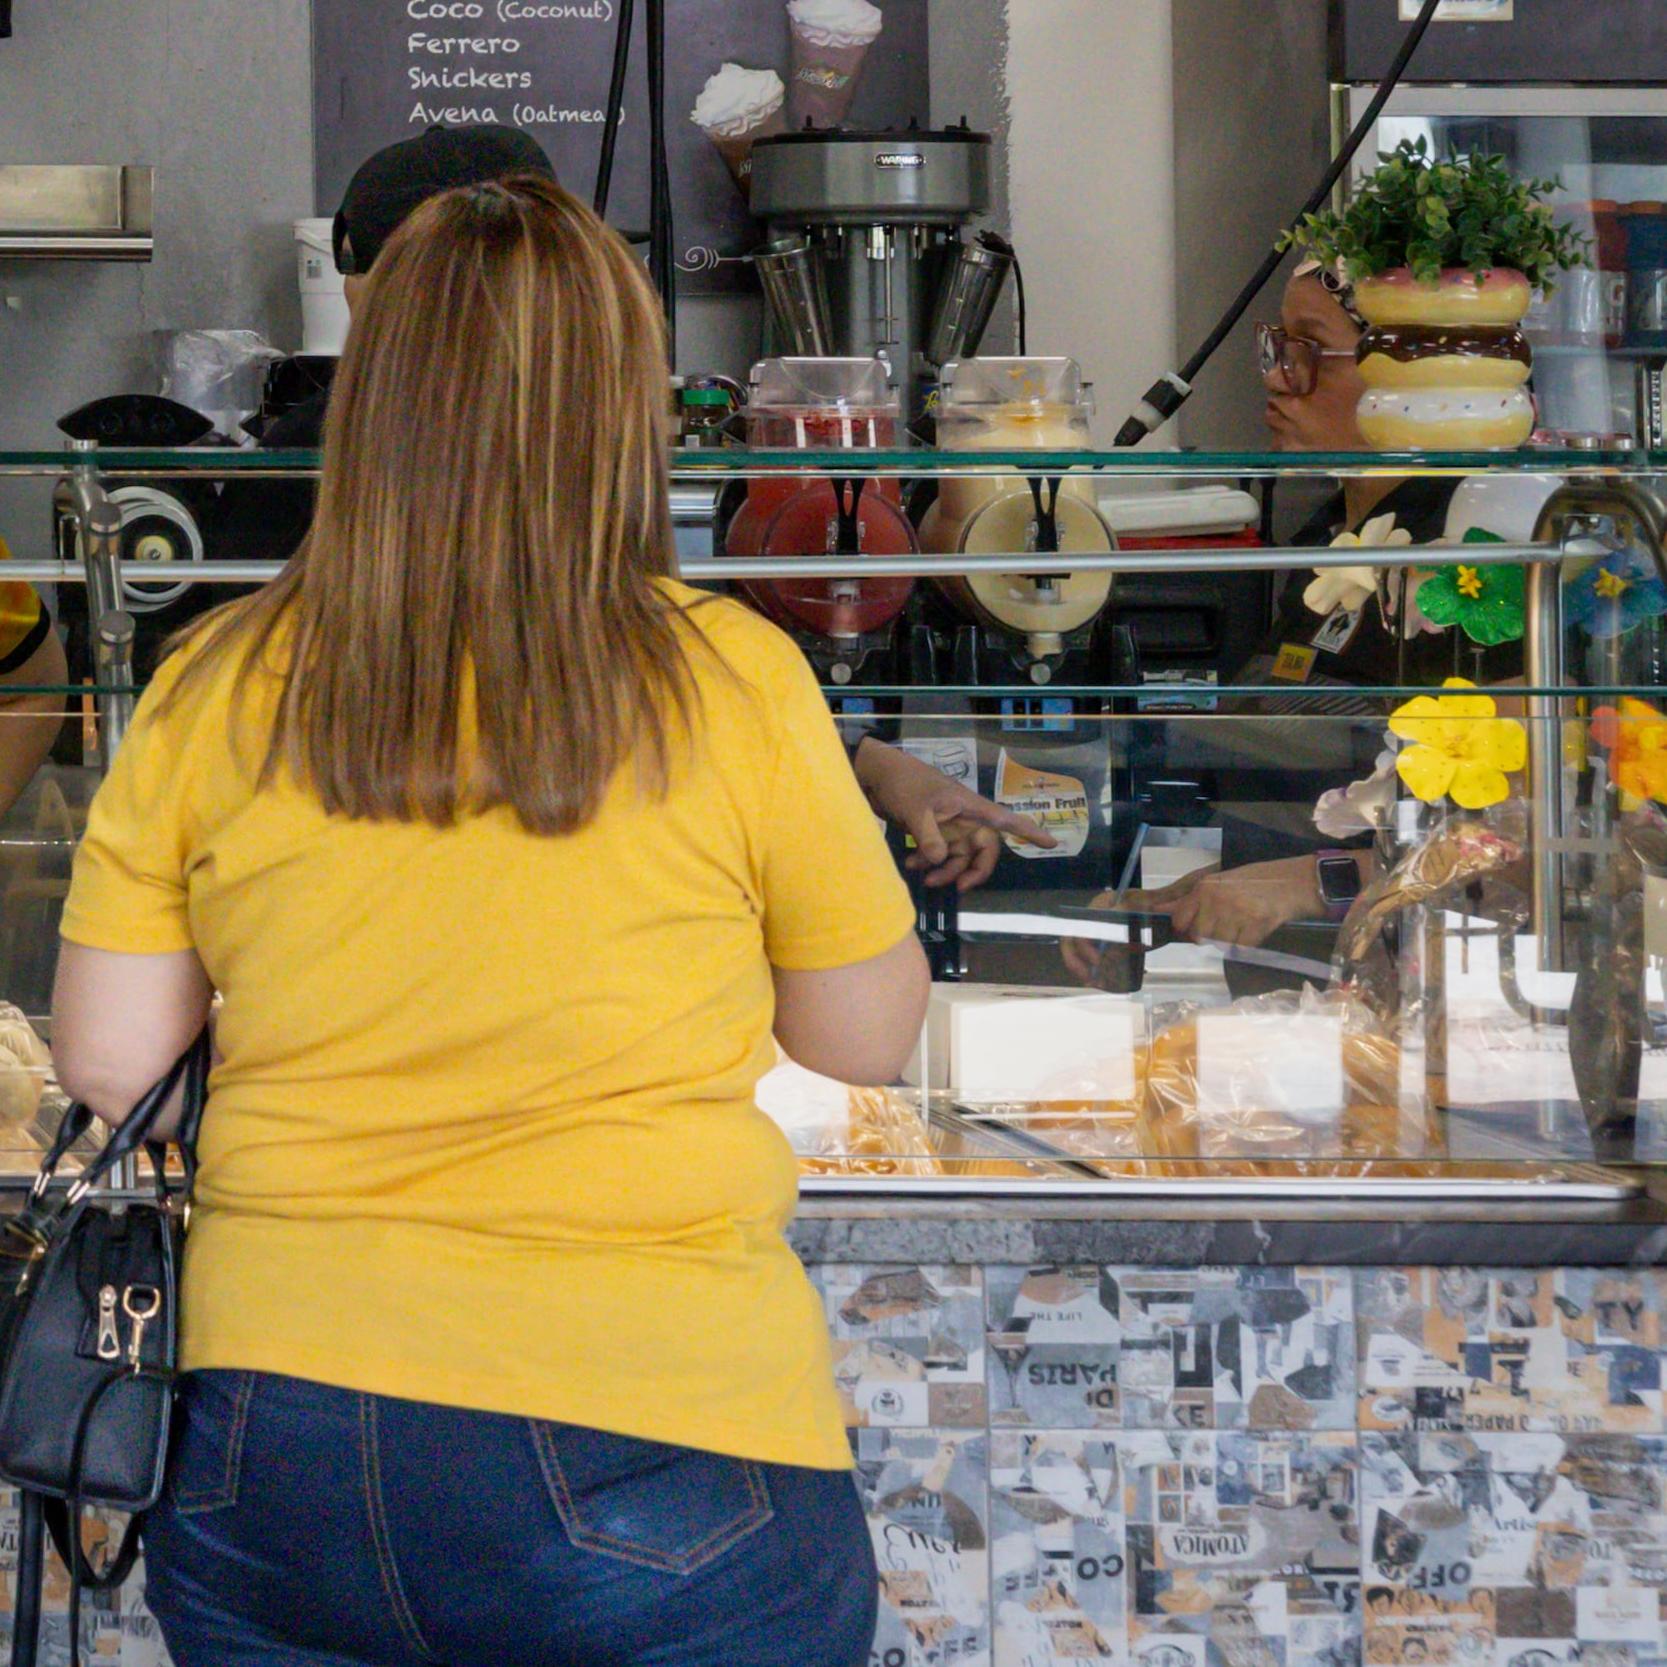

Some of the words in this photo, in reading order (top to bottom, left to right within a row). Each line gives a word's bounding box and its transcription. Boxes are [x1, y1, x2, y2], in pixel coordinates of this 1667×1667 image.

[407, 32, 521, 55] Ferrero
[407, 67, 532, 90] Snickers
[408, 102, 499, 125] Avena
[513, 103, 625, 128] (Oatmea)
